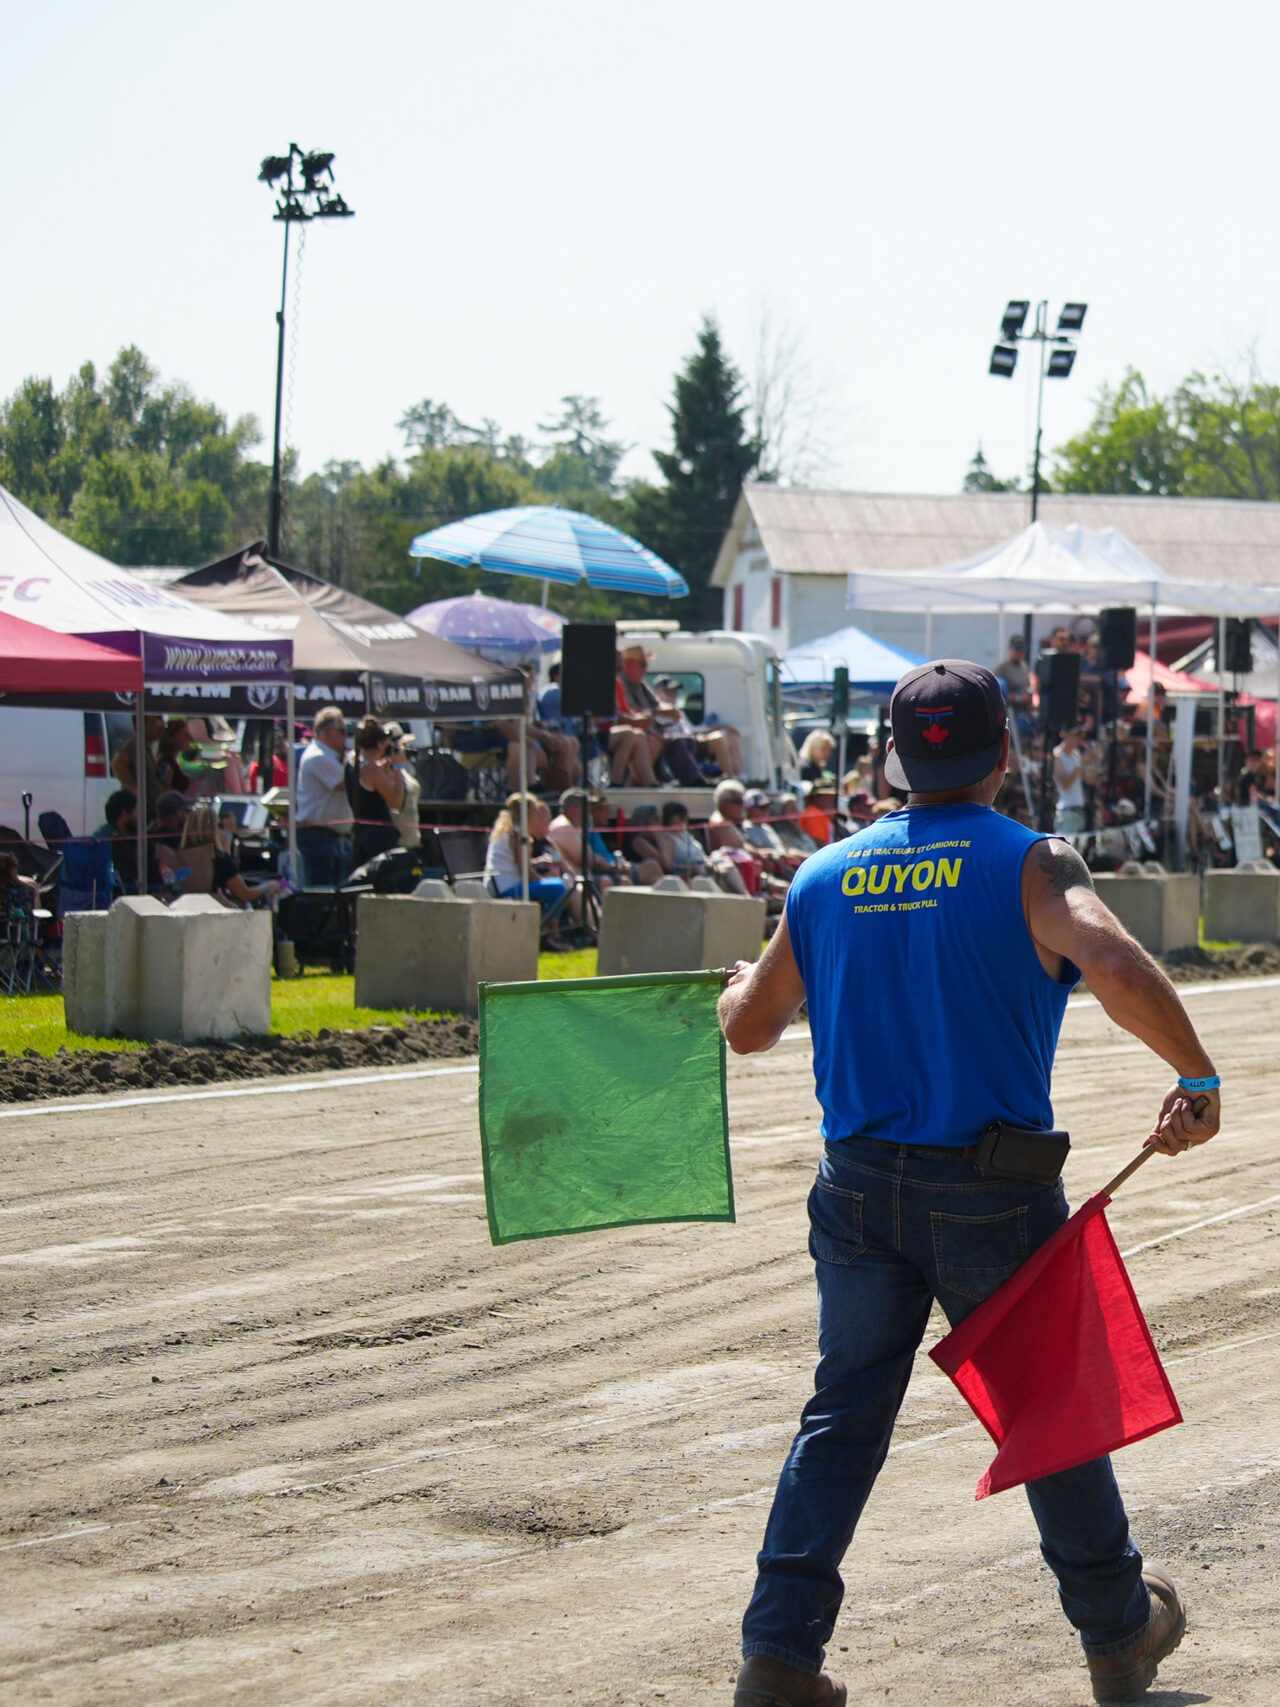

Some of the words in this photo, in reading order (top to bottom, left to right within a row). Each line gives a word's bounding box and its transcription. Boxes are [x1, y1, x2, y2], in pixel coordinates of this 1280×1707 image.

[151, 684, 232, 698] RAM
[285, 685, 365, 701] RAM
[387, 686, 420, 703] RAM
[439, 686, 472, 702] RAM
[491, 683, 524, 699] RAM
[873, 847, 915, 856] TRACTEURS
[916, 846, 926, 854] ET
[926, 840, 960, 851] CAMIONS
[960, 839, 972, 848] DE
[841, 857, 963, 897] QUYON
[854, 903, 889, 914] TRACTOR
[890, 902, 896, 911] &
[897, 901, 921, 911] TRUCK
[921, 899, 938, 908] PULL
